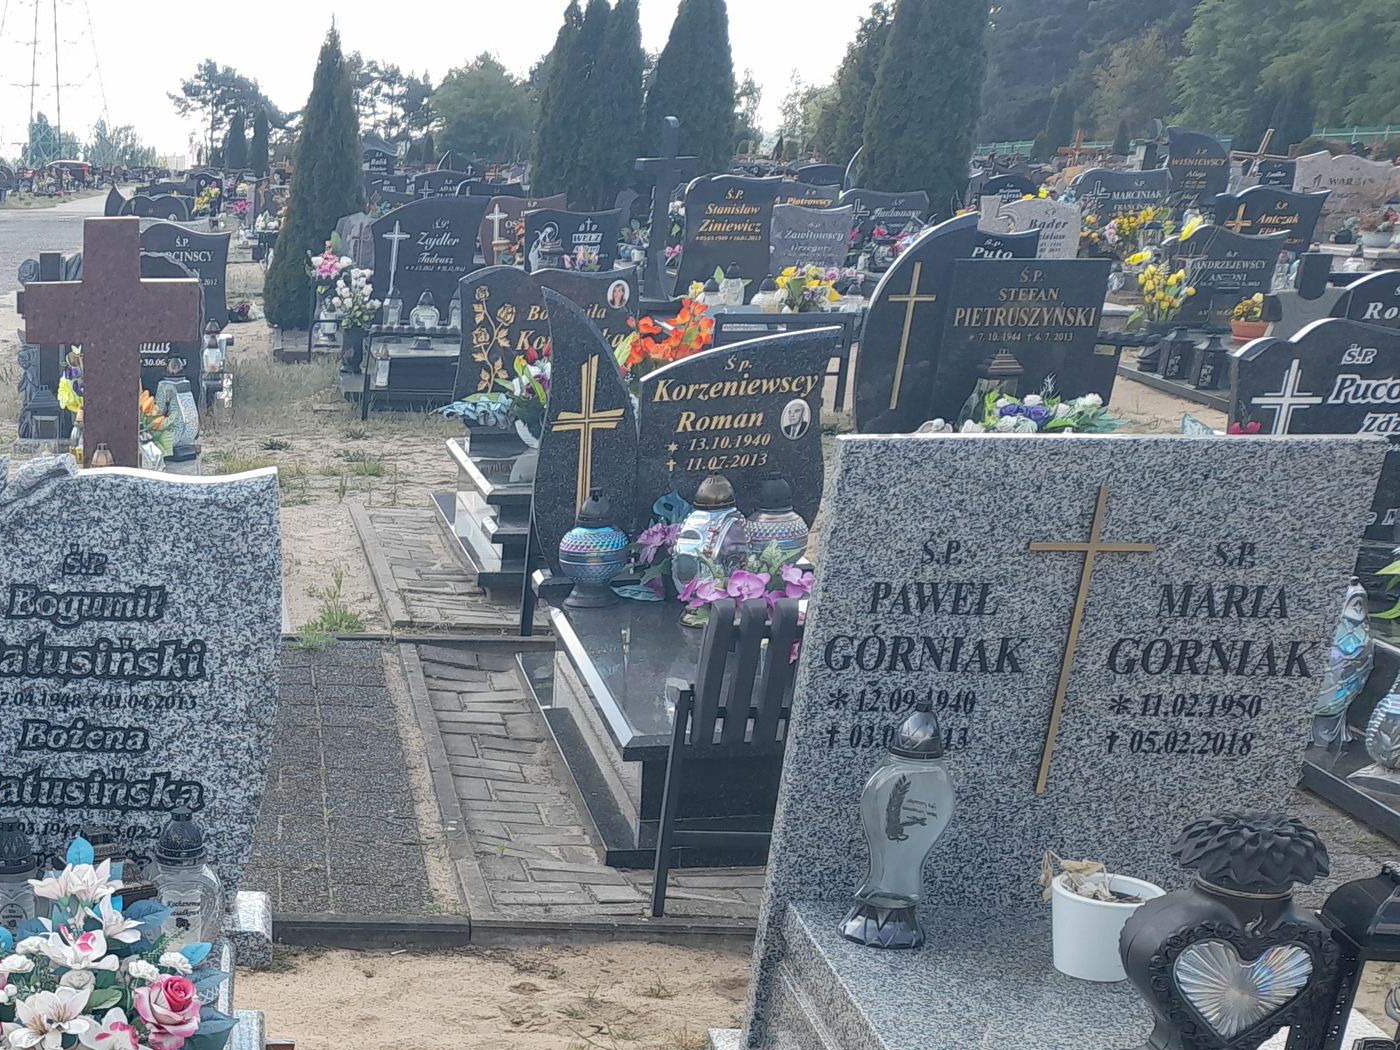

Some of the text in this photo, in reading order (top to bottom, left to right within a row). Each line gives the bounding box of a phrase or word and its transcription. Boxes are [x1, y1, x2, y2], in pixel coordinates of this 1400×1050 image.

[698, 218, 763, 233] Ziniewicz
[416, 231, 460, 250] Zajdler
[1019, 266, 1044, 283] Ś.P.
[998, 287, 1060, 301] STEFAN
[952, 301, 1097, 327] PIETRUSZYŃSKI
[652, 373, 819, 404] Korzeniewscy
[674, 410, 764, 434] Roman
[689, 432, 772, 452] 13.10.1940
[686, 452, 768, 472] 11.07.2013
[1155, 583, 1289, 619] MARIA
[823, 624, 1030, 673] GÓRNIAK
[1106, 627, 1320, 679] GÓRNIAK
[1140, 693, 1263, 719] 11.02.1950
[18, 718, 151, 752] Bożena
[1129, 730, 1254, 756] 05.02.2018
